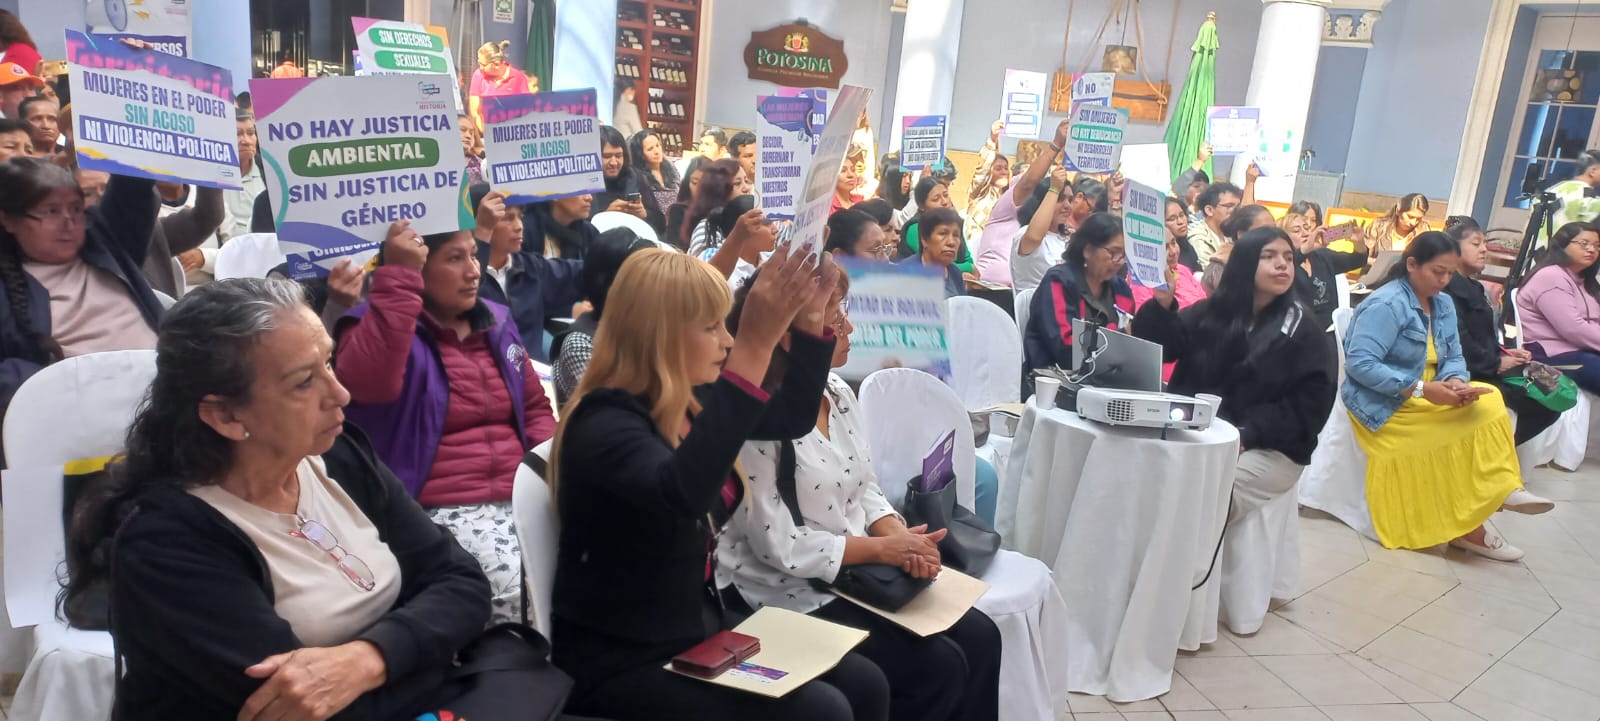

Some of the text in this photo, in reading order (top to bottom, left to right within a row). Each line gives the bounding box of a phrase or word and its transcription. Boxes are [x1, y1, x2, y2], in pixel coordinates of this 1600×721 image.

[378, 30, 433, 48] SIN DERECHOS
[393, 53, 431, 69] SEXUALES
[83, 70, 226, 119] MUJERES EN EL PODER
[1085, 82, 1096, 94] NO
[125, 103, 195, 134] SIN ACOSO
[1080, 109, 1117, 124] SIN MUJERES
[268, 114, 451, 142] NO HAY JUSTICIA
[492, 118, 593, 144] MUJERES EN EL PODER
[1080, 127, 1090, 139] HAY
[85, 119, 232, 163] NI VIOLENCIA POLÍTICA
[521, 139, 571, 160] SIN ACOSO
[762, 136, 784, 149] DECIDIR,
[306, 142, 425, 168] AMBIENTAL
[762, 151, 794, 164] GOBERNAR Y
[1078, 156, 1110, 169] TERRITORIAL
[495, 154, 597, 183] NI VIOLENCIA POLÍTICA
[762, 165, 801, 178] TRANSFORMAR
[288, 170, 458, 204] SIN JUSTICIA DE
[762, 181, 788, 193] NUESTROS
[762, 195, 793, 208] MUNICIPIOS
[1129, 189, 1157, 215] SIN MUJERES
[341, 202, 427, 228] GÉNERO
